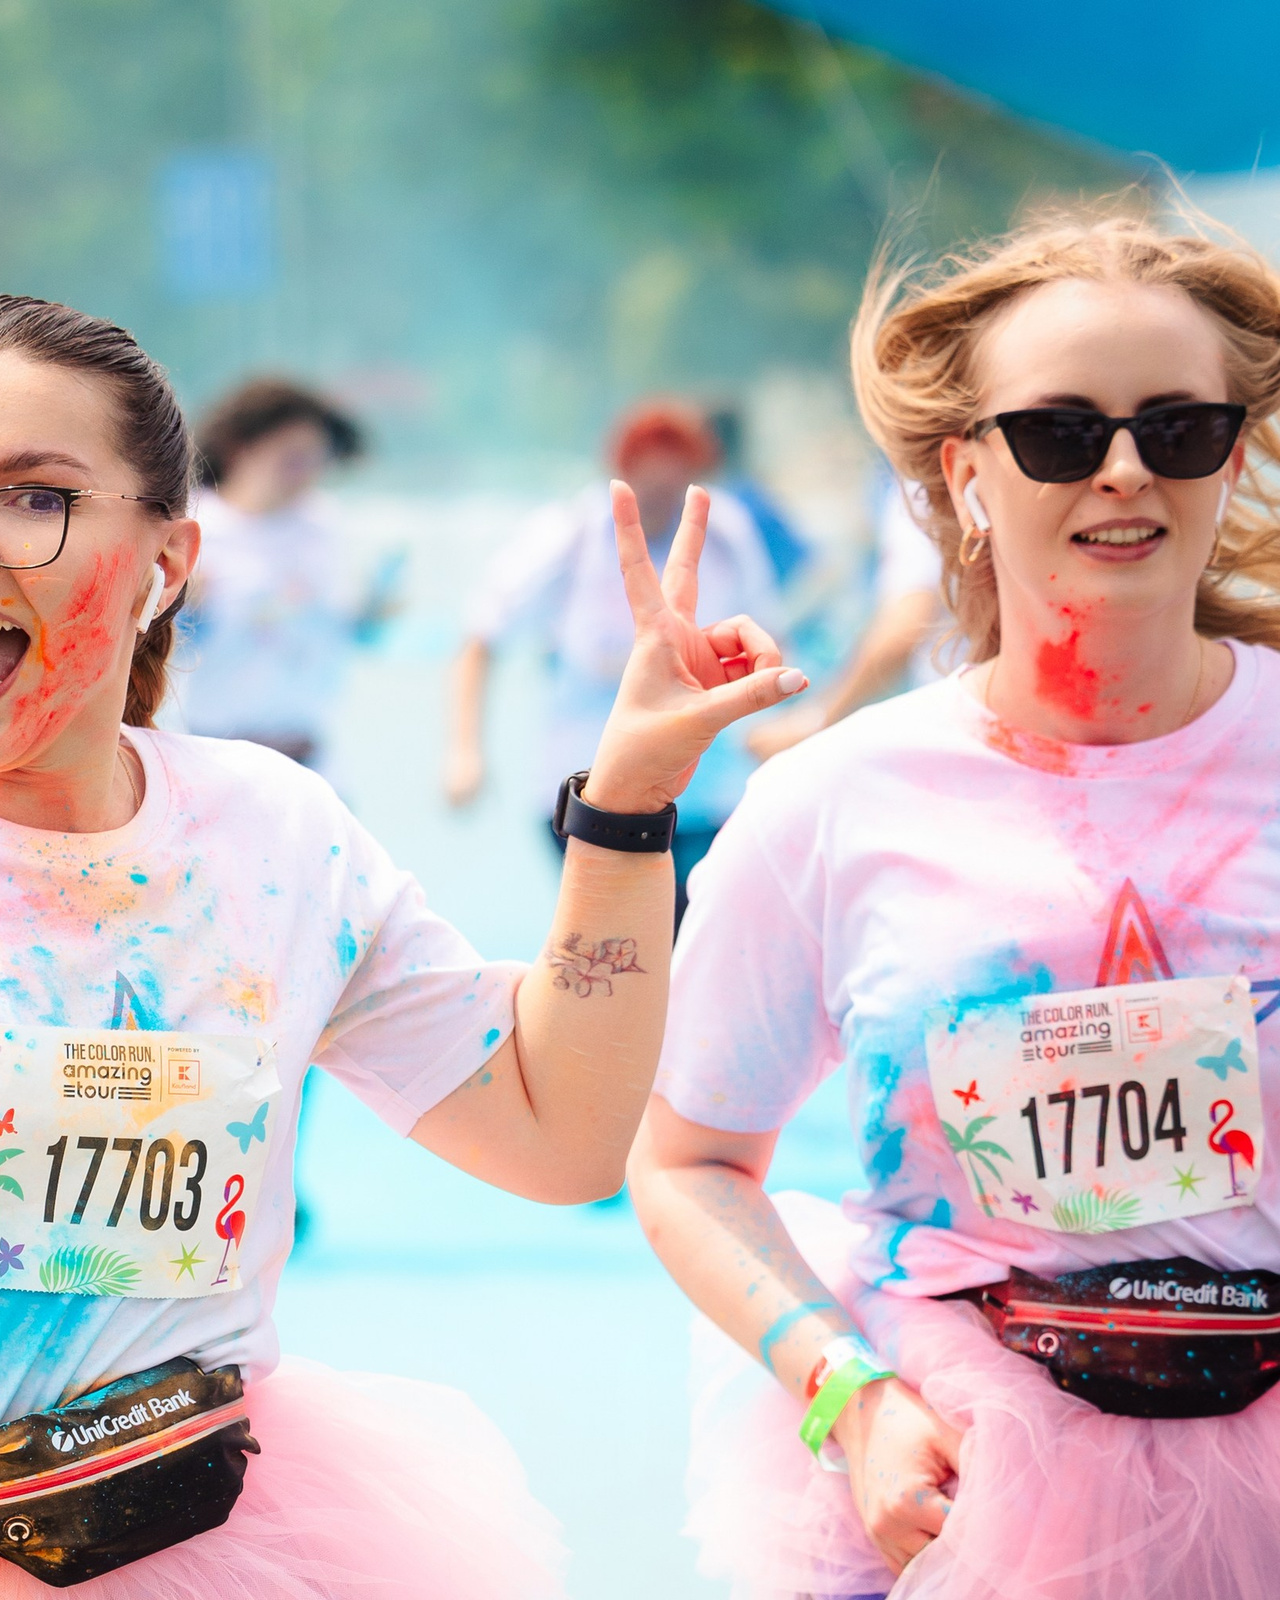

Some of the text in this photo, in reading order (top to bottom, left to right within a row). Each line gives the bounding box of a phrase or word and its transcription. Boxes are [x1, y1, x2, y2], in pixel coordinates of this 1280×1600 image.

[1020, 1010, 1041, 1026] THE
[1043, 1005, 1083, 1023] COLOR
[1020, 1021, 1111, 1042] amazing
[64, 1043, 86, 1060] THE
[88, 1044, 127, 1061] COLOR
[1035, 1044, 1076, 1060] tour
[63, 1062, 152, 1086] amazing
[77, 1081, 117, 1099] tour
[1020, 1078, 1187, 1180] 17704
[43, 1135, 208, 1232] 17703
[1132, 1279, 1268, 1308] UniCredit Bank
[71, 1388, 197, 1445] UniCredit Bank
